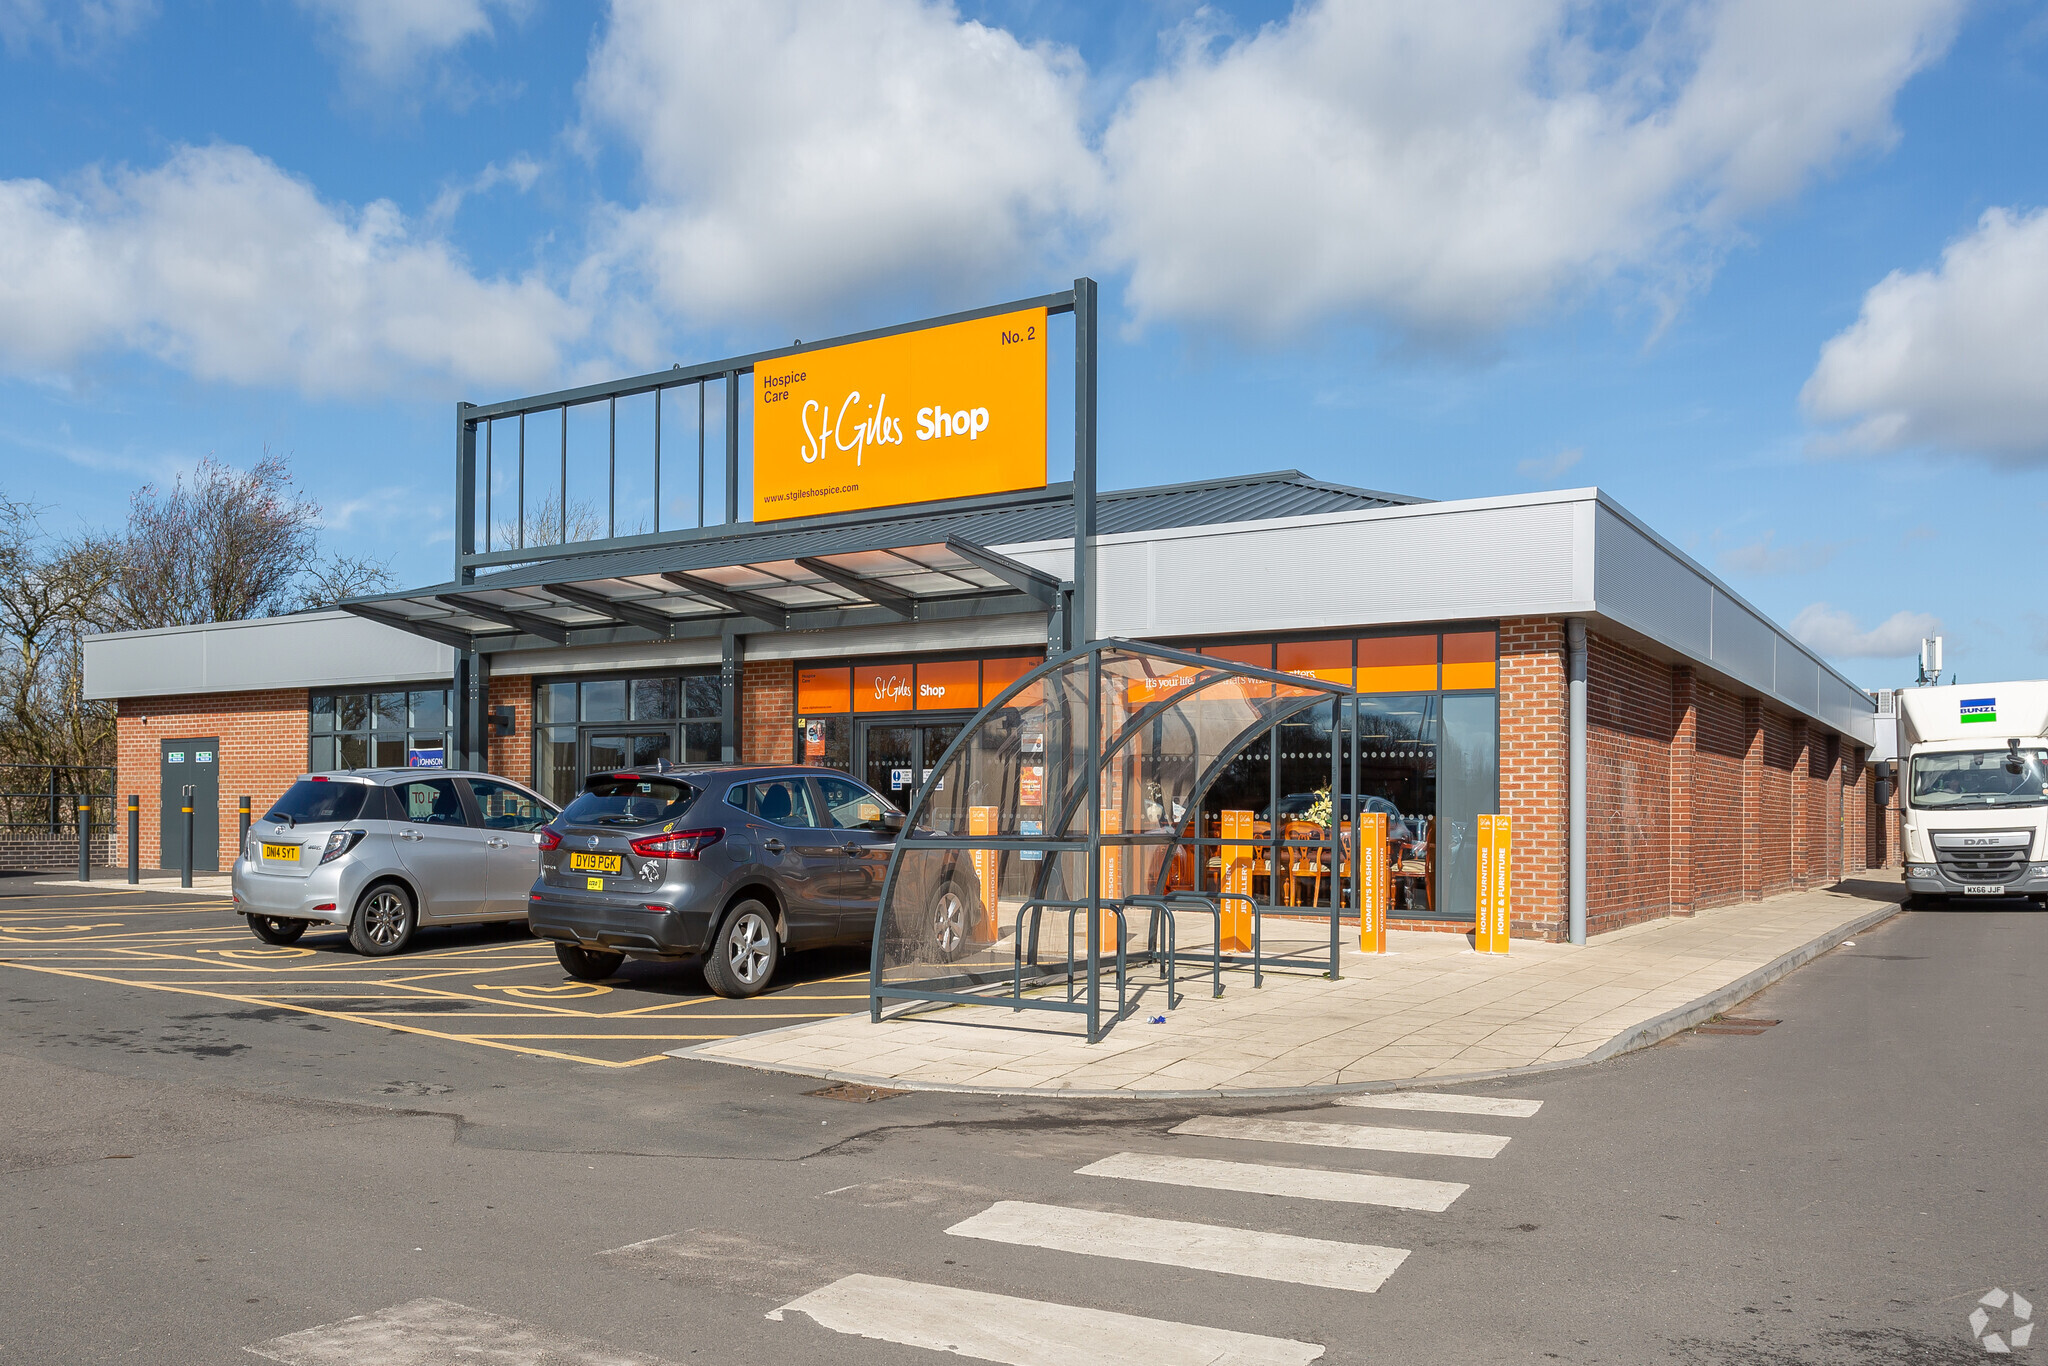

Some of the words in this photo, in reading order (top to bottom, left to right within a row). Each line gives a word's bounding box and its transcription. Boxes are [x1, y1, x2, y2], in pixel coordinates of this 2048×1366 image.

[1001, 330, 1024, 345] No.
[1027, 326, 1036, 341] 2
[764, 370, 807, 388] Hospice
[764, 389, 789, 404] Care
[801, 399, 833, 464] St
[834, 390, 904, 467] Giles
[915, 405, 990, 442] Shop
[763, 482, 859, 503] www.stgileshospice.com
[886, 675, 912, 703] Giles
[919, 684, 946, 698] Shop
[1145, 677, 1158, 689] It's
[1158, 677, 1179, 689] your
[1960, 706, 1996, 714] BUNZL
[419, 757, 443, 766] JOHNSON
[412, 791, 425, 804] TO
[428, 791, 440, 804] LE
[1964, 838, 1999, 846] DAF
[266, 846, 280, 857] DN14
[282, 847, 295, 859] SYT
[576, 854, 595, 868] DY19
[598, 856, 617, 869] PGK
[1481, 898, 1487, 906] &
[1498, 898, 1505, 907] &
